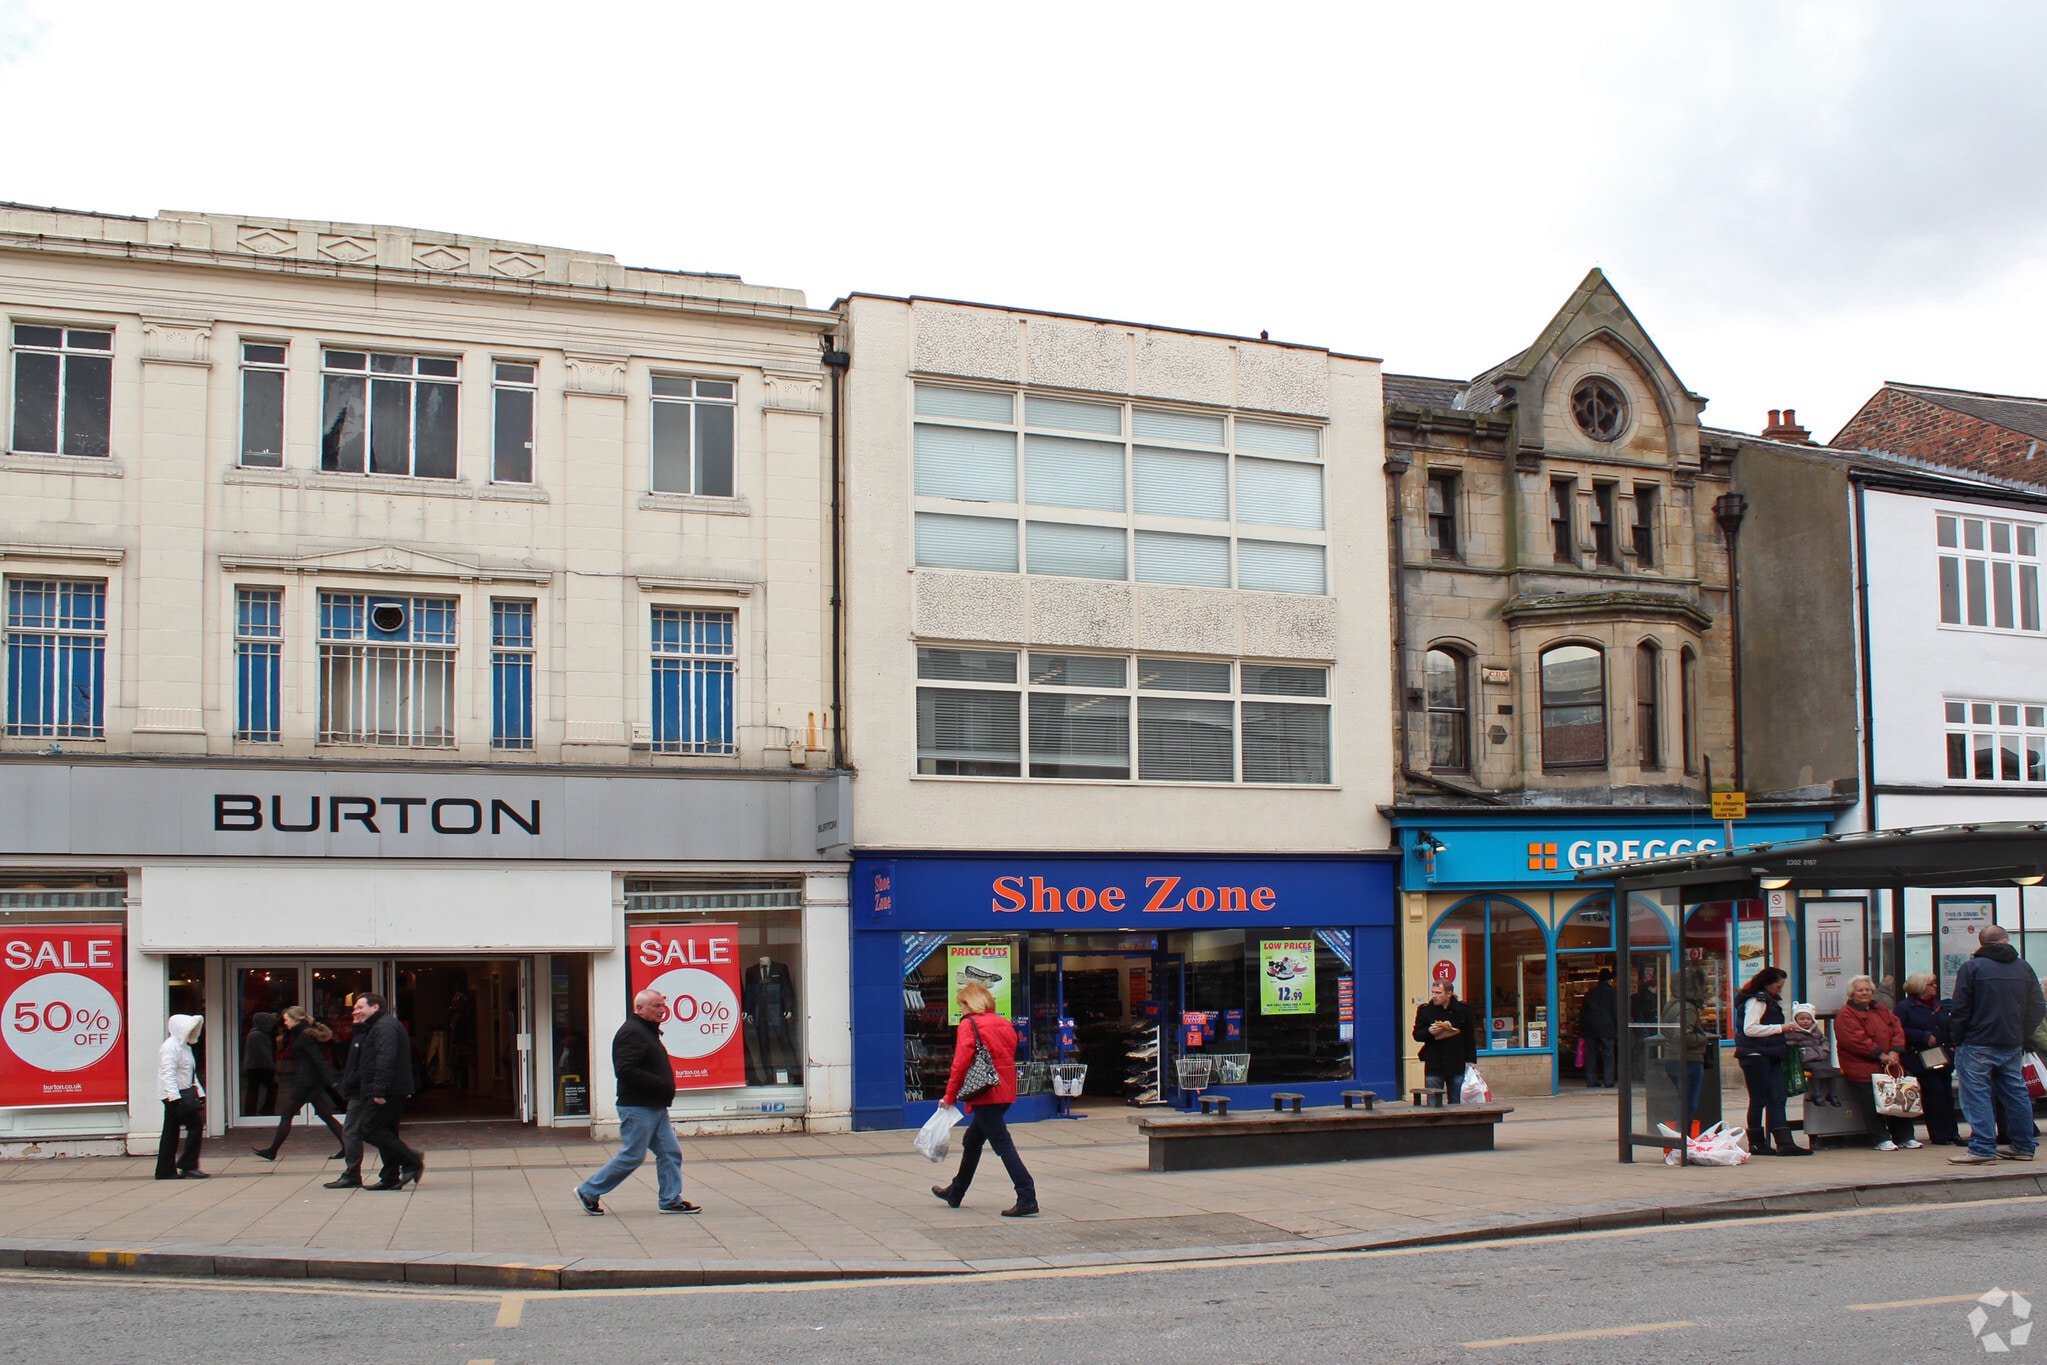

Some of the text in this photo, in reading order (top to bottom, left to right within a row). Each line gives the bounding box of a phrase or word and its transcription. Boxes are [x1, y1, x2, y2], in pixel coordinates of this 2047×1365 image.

[214, 794, 541, 835] BURTON
[992, 876, 1276, 912] Shoe Zone
[5, 940, 113, 970] SALE
[640, 938, 731, 966] SALE
[951, 947, 1008, 956] PRICE CUTS
[1439, 968, 1449, 978] £1
[1278, 987, 1303, 1001] 12.99
[14, 1001, 111, 1034] 50%
[74, 1033, 109, 1046] OFF
[700, 1023, 729, 1035] OFF
